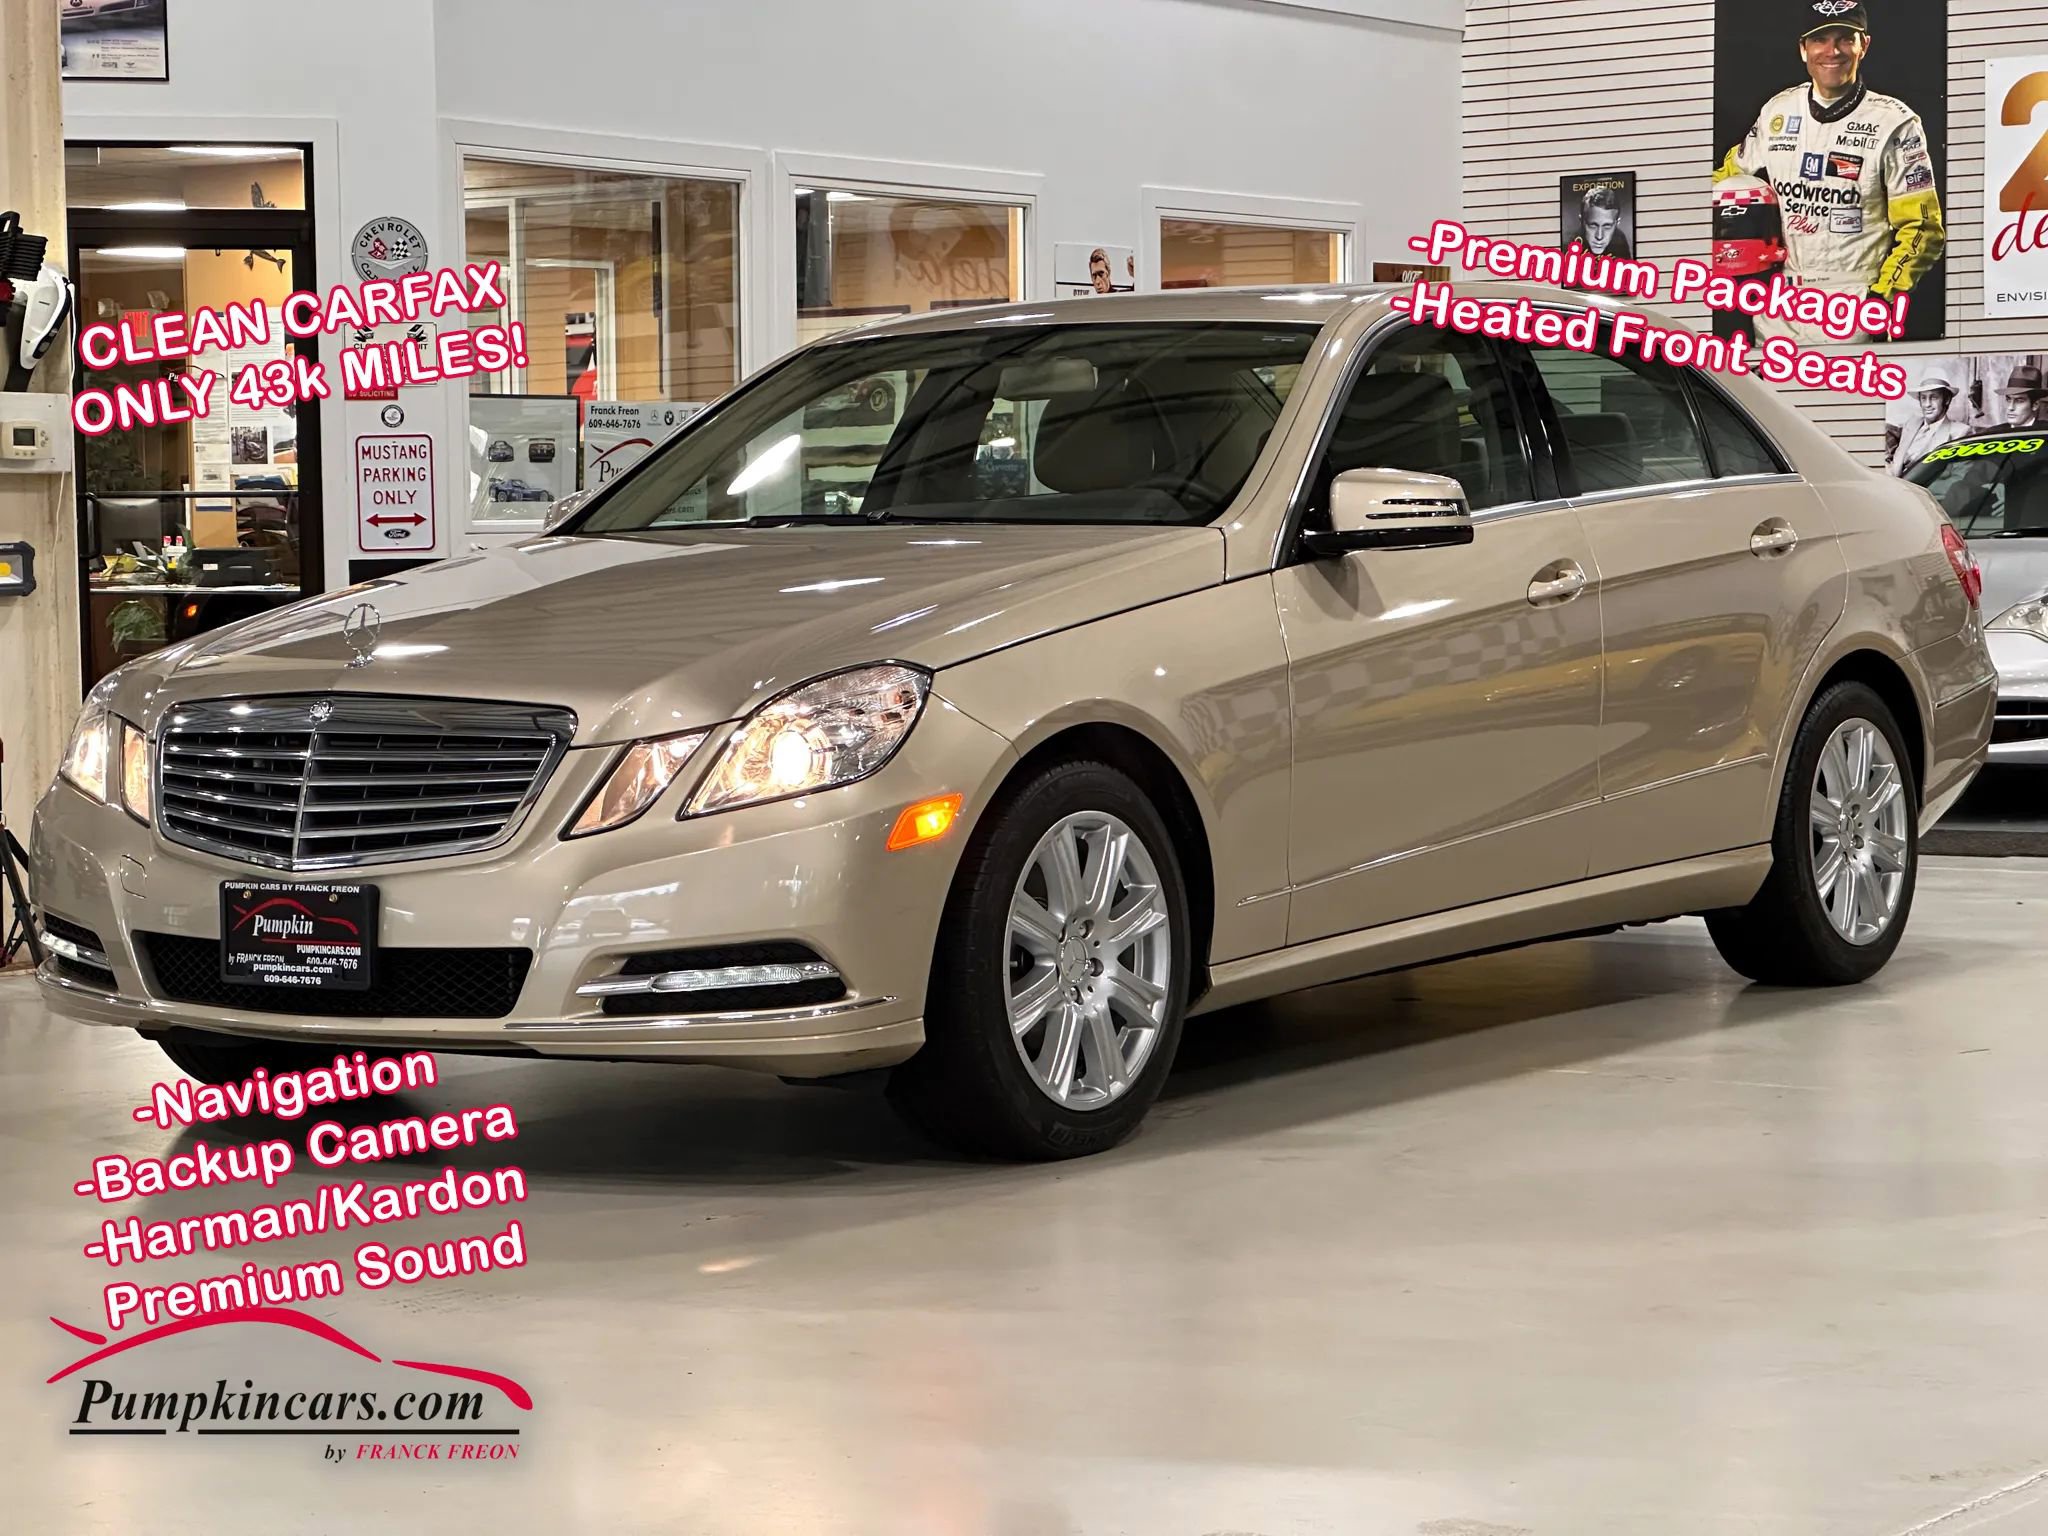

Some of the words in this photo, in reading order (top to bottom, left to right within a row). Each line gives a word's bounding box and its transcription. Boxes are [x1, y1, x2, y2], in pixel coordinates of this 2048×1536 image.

[1846, 121, 1880, 133] GMAC
[1836, 134, 1867, 149] Mobil
[1805, 156, 1819, 173] GM
[1906, 172, 1923, 184] elf
[1573, 181, 1625, 192] EXPOSITION
[1785, 199, 1829, 217] Service
[1787, 214, 1820, 234] Plus
[359, 222, 422, 249] CHEVROLET
[590, 405, 617, 416] Franck
[618, 406, 640, 416] Freon
[588, 419, 641, 429] 609-646-7676
[361, 444, 427, 460] MUSTANG
[363, 467, 427, 482] PARKING
[373, 490, 417, 505] ONLY
[388, 530, 406, 538] Ford
[225, 882, 259, 890] PUMPKIN
[260, 883, 281, 891] CARS
[295, 884, 329, 893] FRANCK
[331, 885, 360, 894] FREON
[252, 914, 314, 939] Pumpkin
[296, 944, 362, 956] PUMPKINCARS.COM
[228, 953, 236, 965] by
[236, 952, 261, 964] FRANCK
[262, 954, 285, 963] FREON
[253, 962, 333, 974] pumpkincars.com
[264, 975, 322, 985] 609-646-7676
